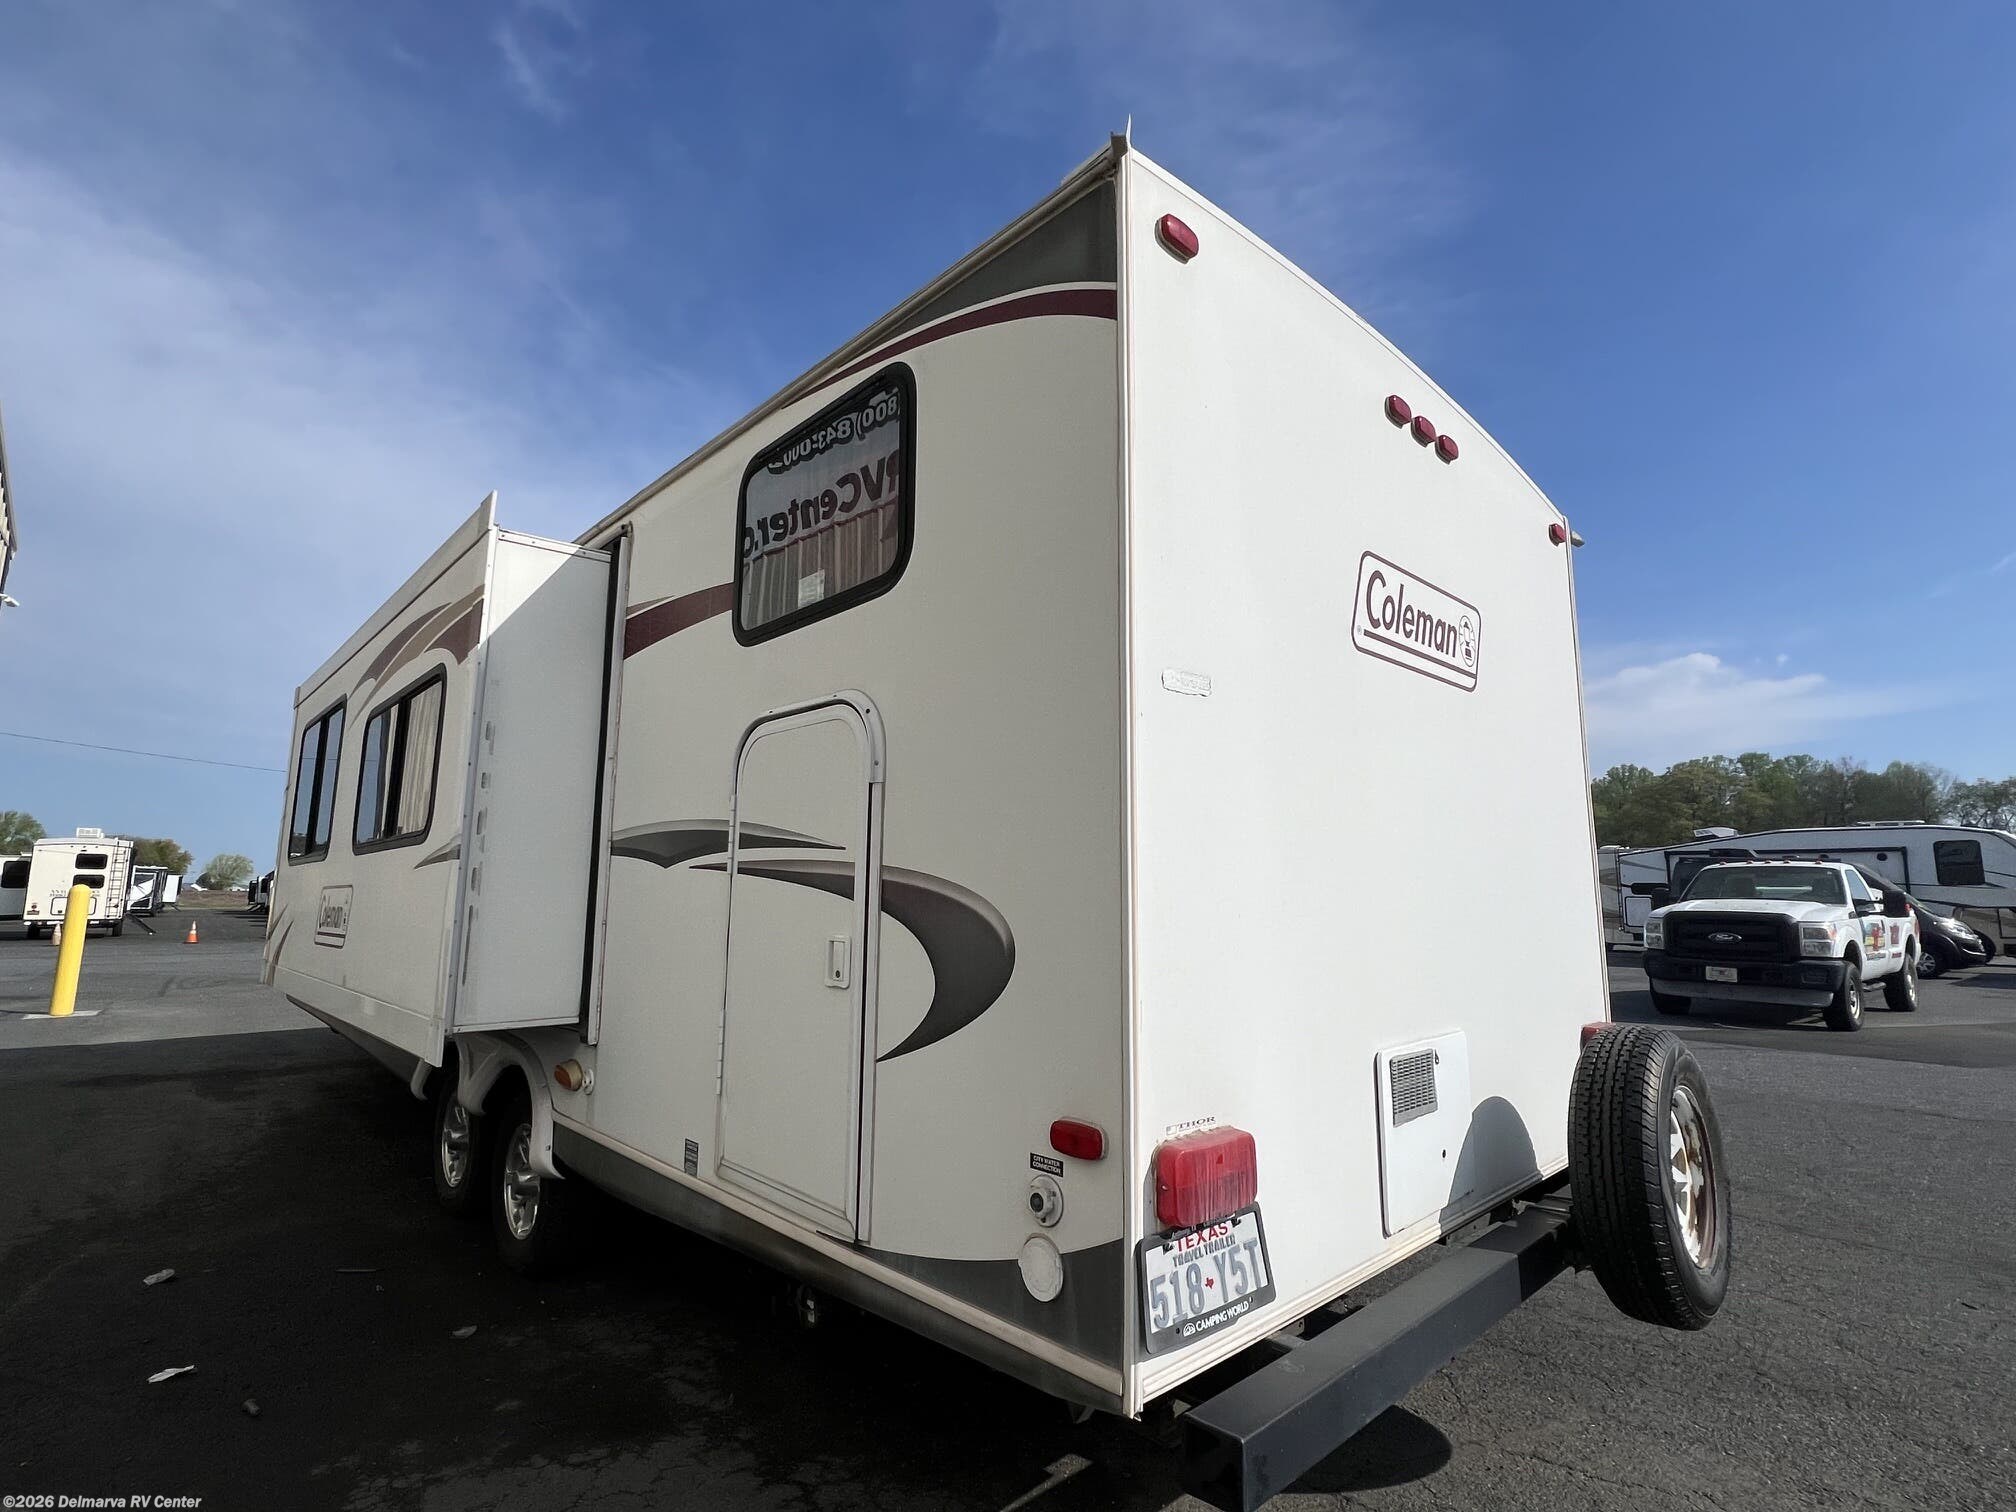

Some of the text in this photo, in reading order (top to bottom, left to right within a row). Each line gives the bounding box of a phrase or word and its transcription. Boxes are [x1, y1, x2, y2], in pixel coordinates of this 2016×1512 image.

[1366, 570, 1458, 658] Coleman
[1178, 1116, 1215, 1129] THOR
[1172, 1234, 1236, 1268] TRAVEL TRAILER
[1177, 1222, 1229, 1252] TEXAS
[1150, 1240, 1262, 1329] 518 Y5T
[1195, 1300, 1249, 1332] CAMPING WORLD
